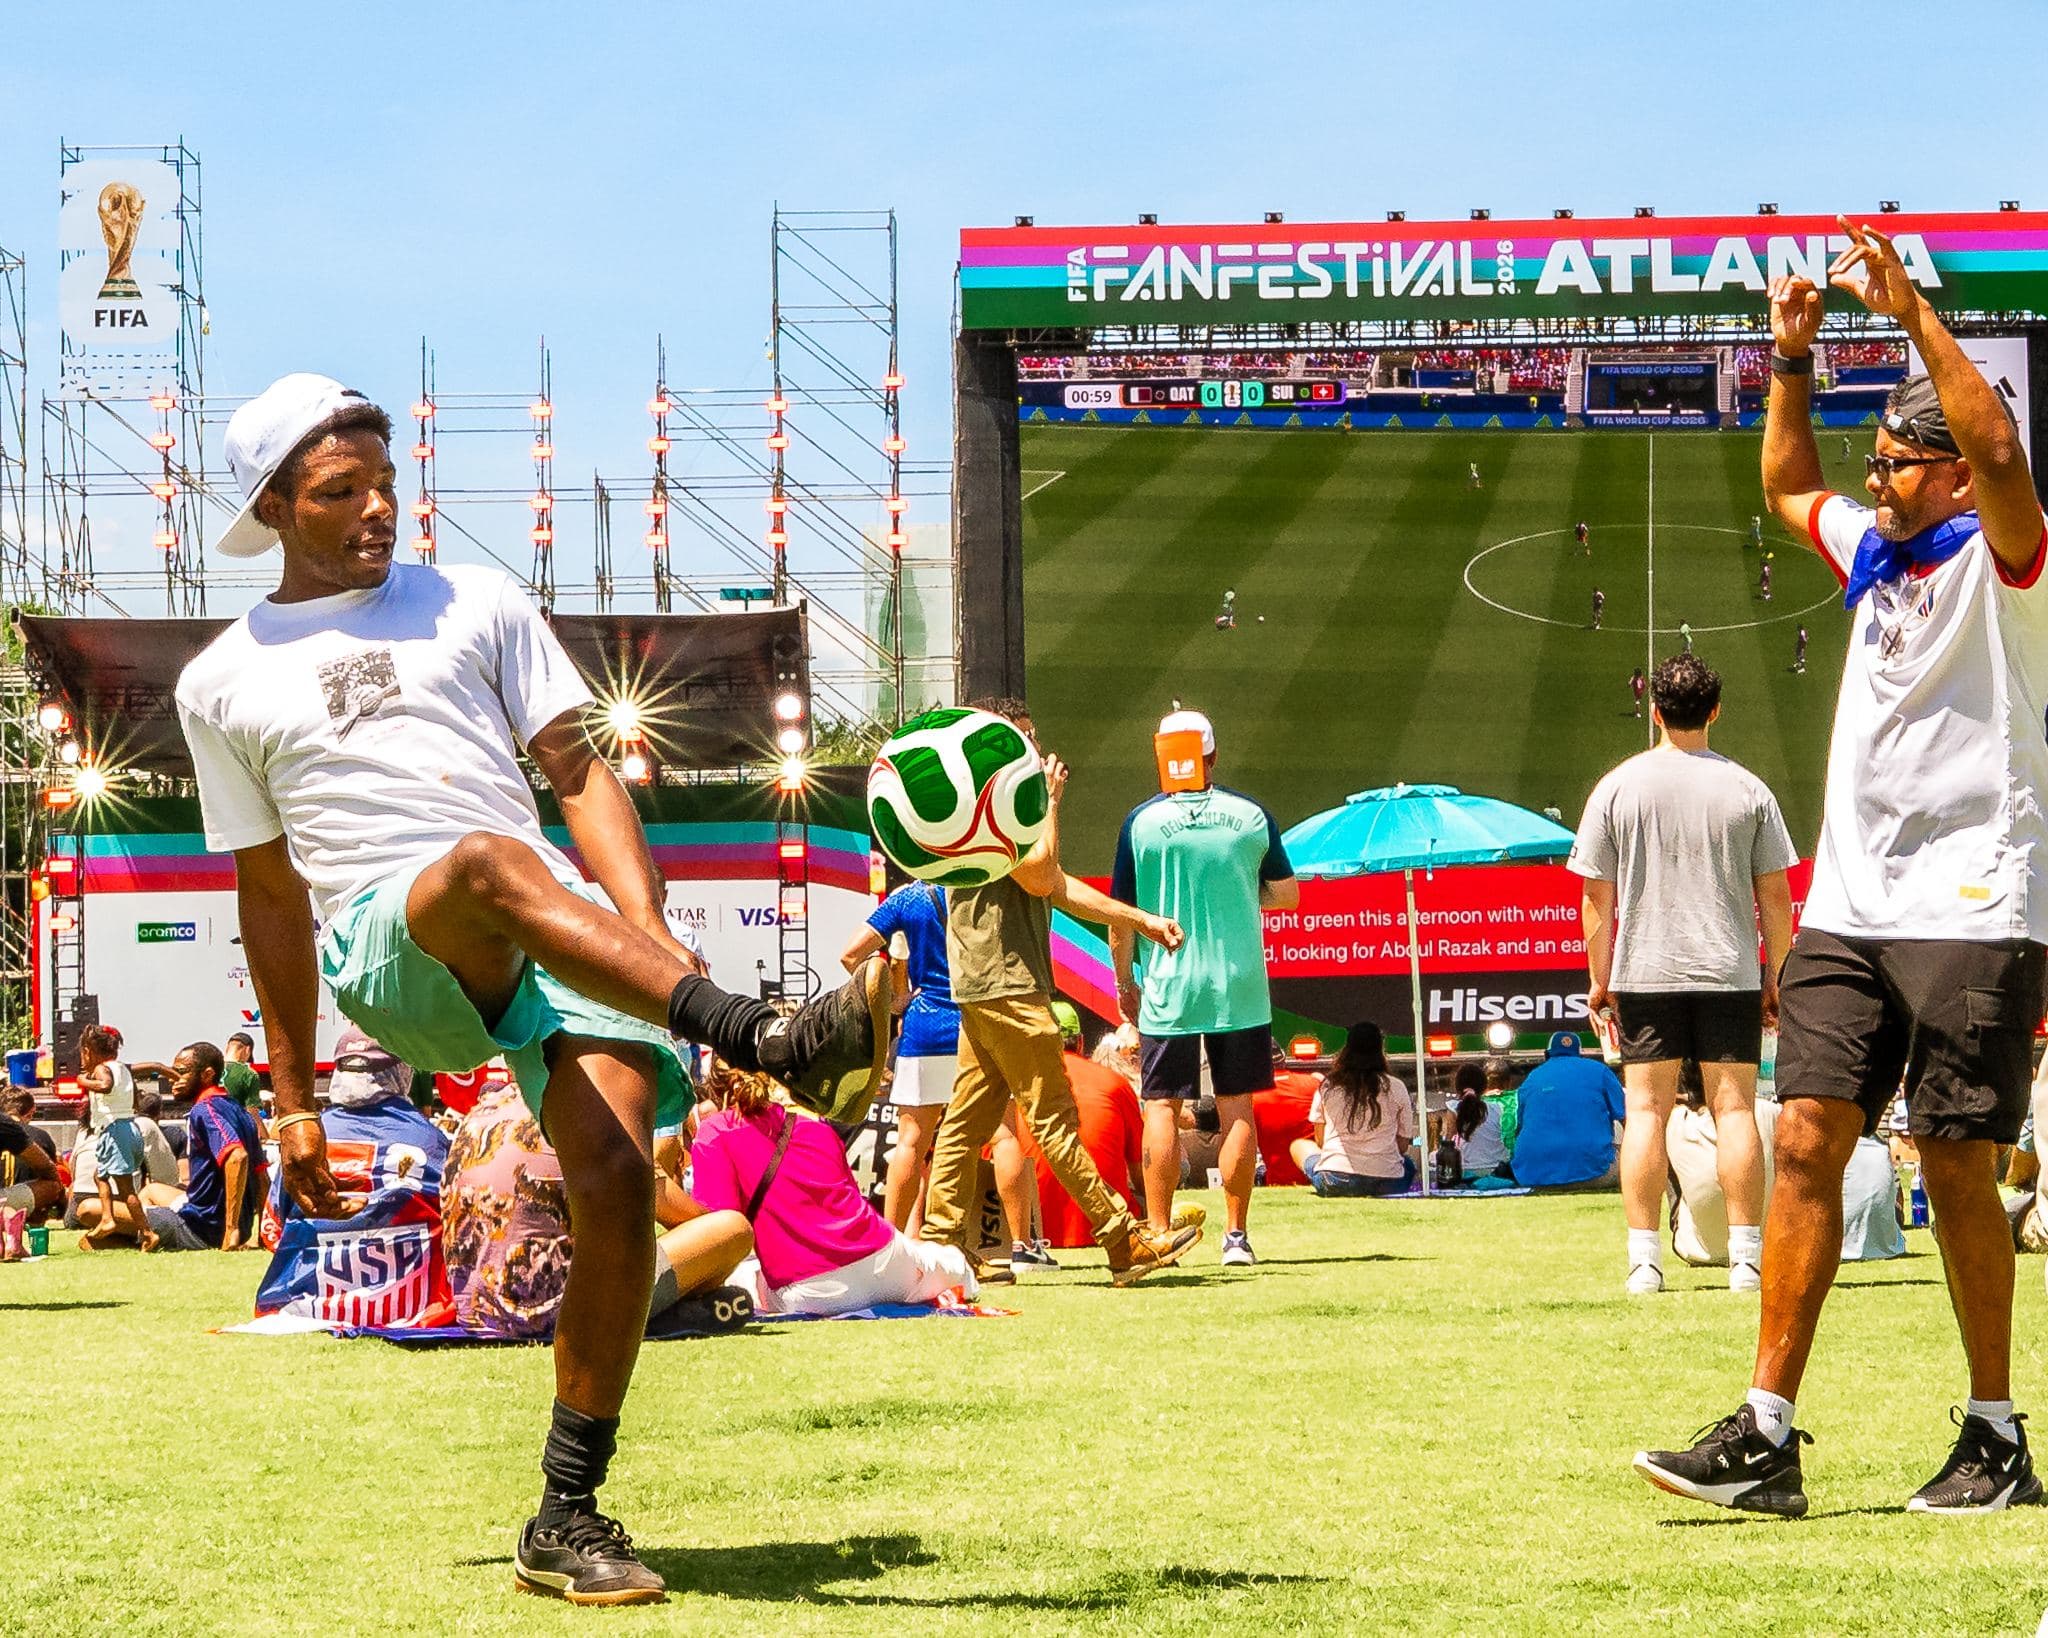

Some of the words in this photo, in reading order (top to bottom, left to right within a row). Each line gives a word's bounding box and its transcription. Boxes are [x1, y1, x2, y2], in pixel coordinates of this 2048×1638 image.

[1067, 247, 1087, 302] FIFA
[1496, 239, 1517, 296] 2026
[94, 309, 149, 328] FIFA
[1621, 366, 1653, 375] WORLD
[1653, 366, 1672, 375] CUP
[1071, 390, 1112, 404] 00:59
[1170, 386, 1196, 402] QAT
[1206, 387, 1218, 403] 0
[1247, 387, 1259, 402] 0
[1272, 385, 1294, 400] SUI
[1593, 416, 1614, 425] FIFA
[1615, 416, 1651, 425] WORLD
[1651, 416, 1671, 425] CUP
[1159, 812, 1243, 839] DEUTCHLAND
[666, 907, 706, 921] ATAR
[734, 907, 791, 926] VISA
[1261, 912, 1299, 933] light
[1303, 911, 1355, 932] green
[1359, 909, 1392, 927] this
[1396, 908, 1482, 926] aternoon
[1487, 905, 1525, 923] with
[1529, 904, 1578, 922] white
[139, 926, 195, 938] aramco
[1282, 943, 1348, 963] looking
[1352, 941, 1376, 959] for
[1438, 938, 1492, 957] Razak
[1496, 937, 1530, 955] and
[1534, 940, 1556, 954] an
[1429, 988, 1590, 1023] Hisens
[978, 1189, 1002, 1250] VISA
[323, 1231, 423, 1290] USA
